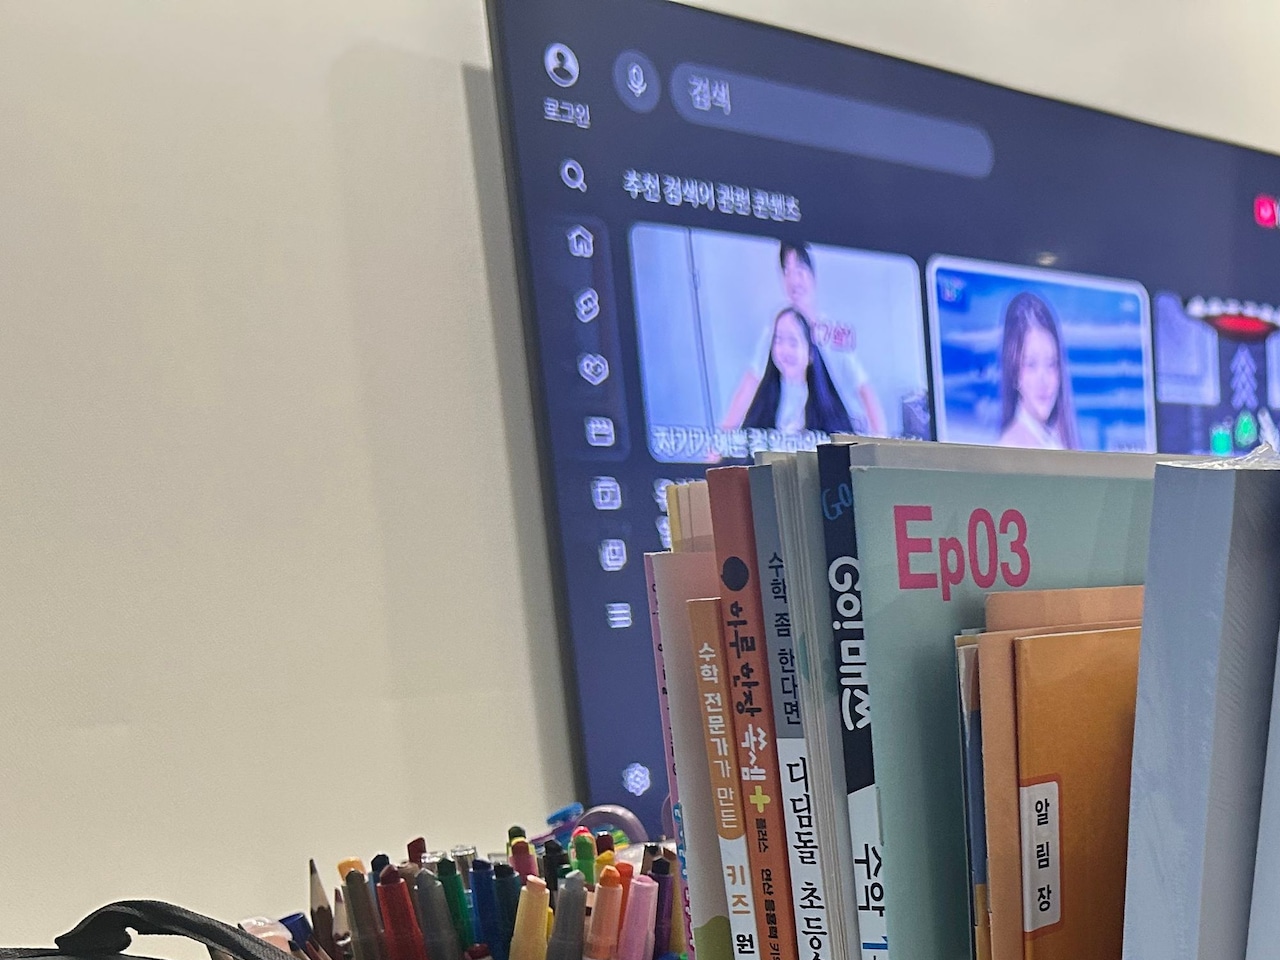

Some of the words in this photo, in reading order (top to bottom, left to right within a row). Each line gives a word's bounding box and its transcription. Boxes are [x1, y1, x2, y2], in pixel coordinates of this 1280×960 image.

[543, 97, 591, 129] 로그인
[768, 552, 788, 604] 수학
[893, 505, 1031, 601] Ep03
[726, 601, 757, 660] 하루
[774, 612, 791, 637] 좀
[698, 642, 719, 685] 수학
[733, 661, 763, 718] 한장
[778, 648, 801, 725] 한다면
[703, 692, 732, 779] 전문가가
[716, 787, 738, 830] 만든
[786, 756, 818, 865] 디딤돌
[726, 865, 751, 915] 키즈
[761, 868, 774, 896] 연산
